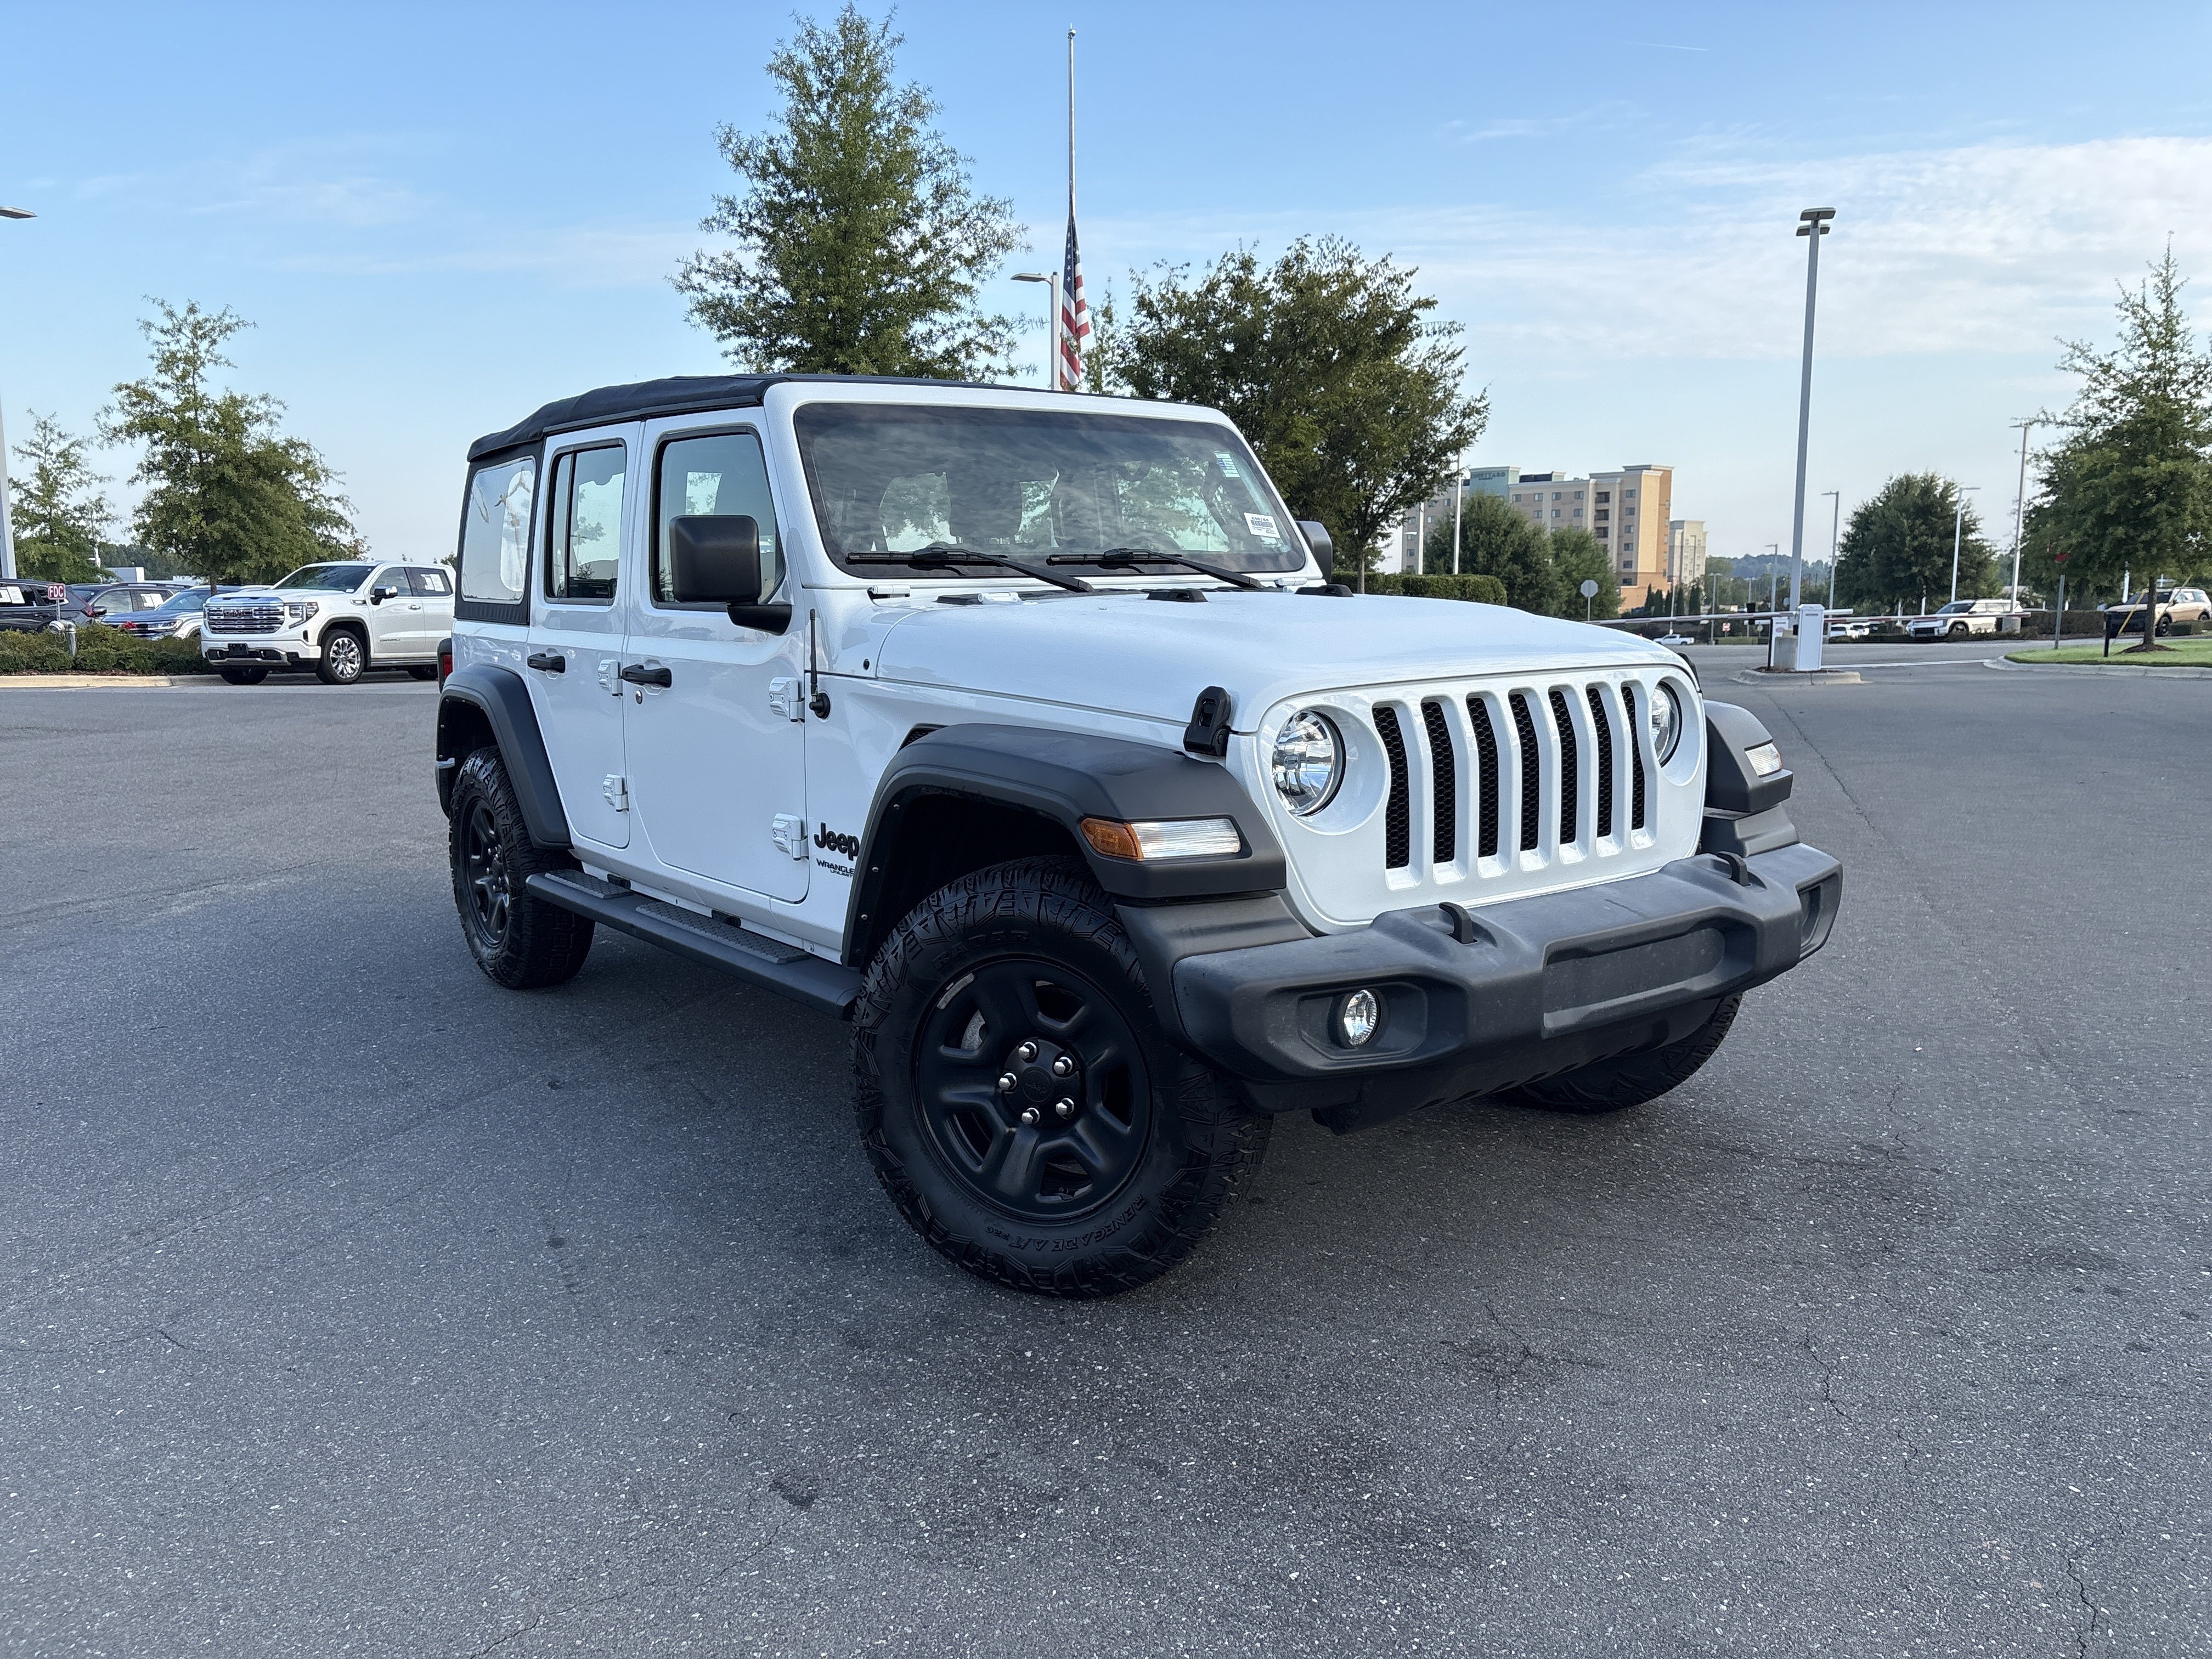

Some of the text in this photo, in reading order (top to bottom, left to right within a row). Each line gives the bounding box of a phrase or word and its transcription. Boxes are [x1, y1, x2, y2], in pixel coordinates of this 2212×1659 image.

[49, 585, 64, 597] FDC
[814, 822, 859, 861] Jeep
[816, 858, 855, 874] WRANGLE
[1051, 1193, 1149, 1252] RENEGADE
